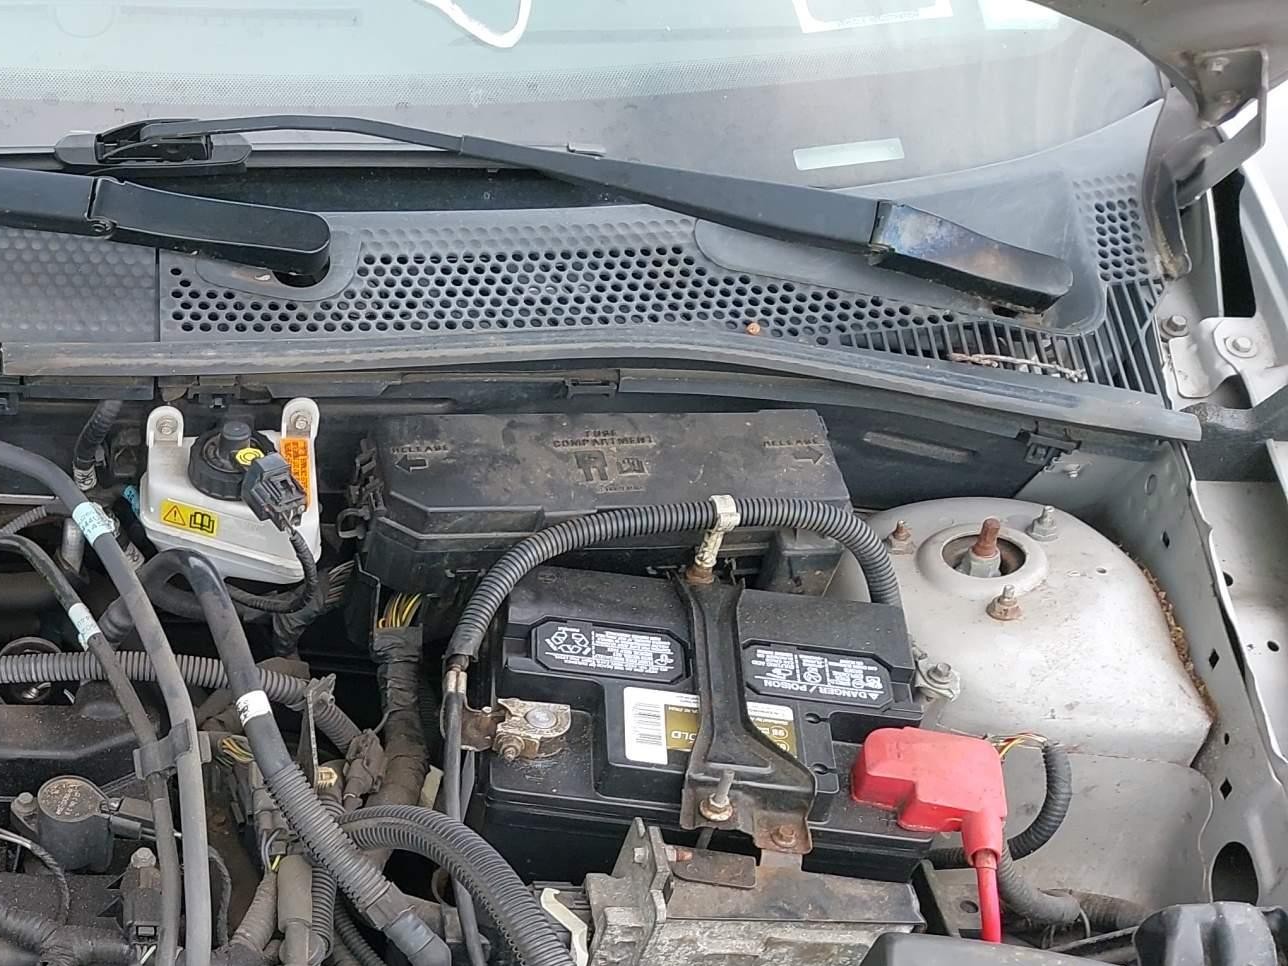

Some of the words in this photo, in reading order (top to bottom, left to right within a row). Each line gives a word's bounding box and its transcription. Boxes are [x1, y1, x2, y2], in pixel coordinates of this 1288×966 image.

[552, 434, 654, 449] COMPARTMENT
[759, 438, 819, 448] RELEASE
[391, 444, 450, 454] RELEASE
[763, 679, 808, 693] POISON
[819, 684, 868, 700] DANGER
[671, 730, 697, 741] OLD
